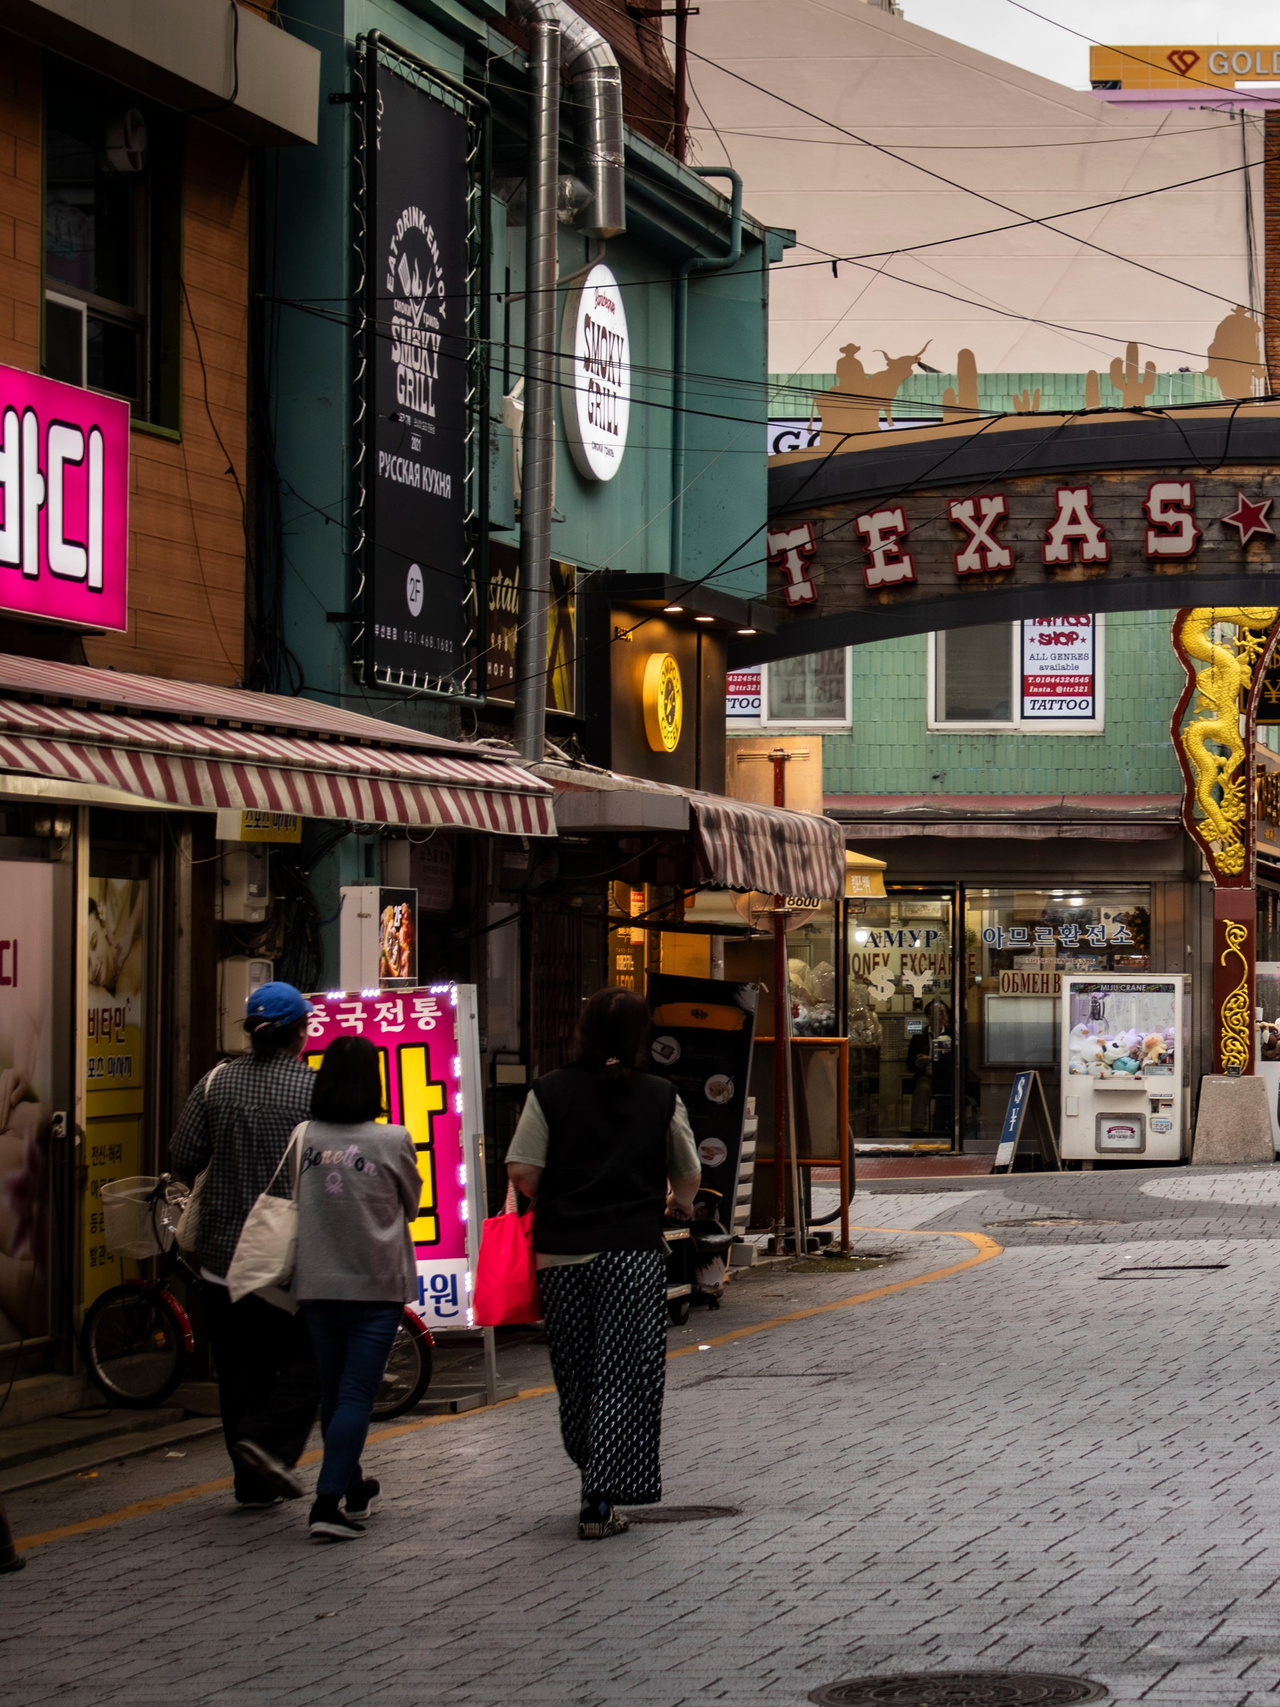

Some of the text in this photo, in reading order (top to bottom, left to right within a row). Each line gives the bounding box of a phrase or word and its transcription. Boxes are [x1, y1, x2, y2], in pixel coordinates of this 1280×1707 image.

[387, 234, 399, 293] EAT
[396, 206, 428, 242] DRINK
[391, 315, 442, 380] SMOKY
[584, 312, 625, 388] SMOKY
[396, 363, 437, 418] GRILL
[587, 377, 619, 437] GRILL
[378, 450, 452, 500] РУССКАЯ КУХНЯ
[768, 480, 1201, 606] TEXAS
[409, 577, 421, 602] 2F
[1038, 631, 1079, 646] SHOP
[727, 698, 761, 709] TOO
[1029, 699, 1090, 711] TATTOO
[863, 929, 939, 948] АМУР
[848, 952, 977, 976] ONEY EXCHAE
[902, 969, 934, 998] ¥
[1001, 972, 1049, 994] ОБМЕН
[1120, 984, 1147, 992] CRANE
[304, 997, 443, 1036] 중국전통
[301, 1146, 378, 1178] Benetton
